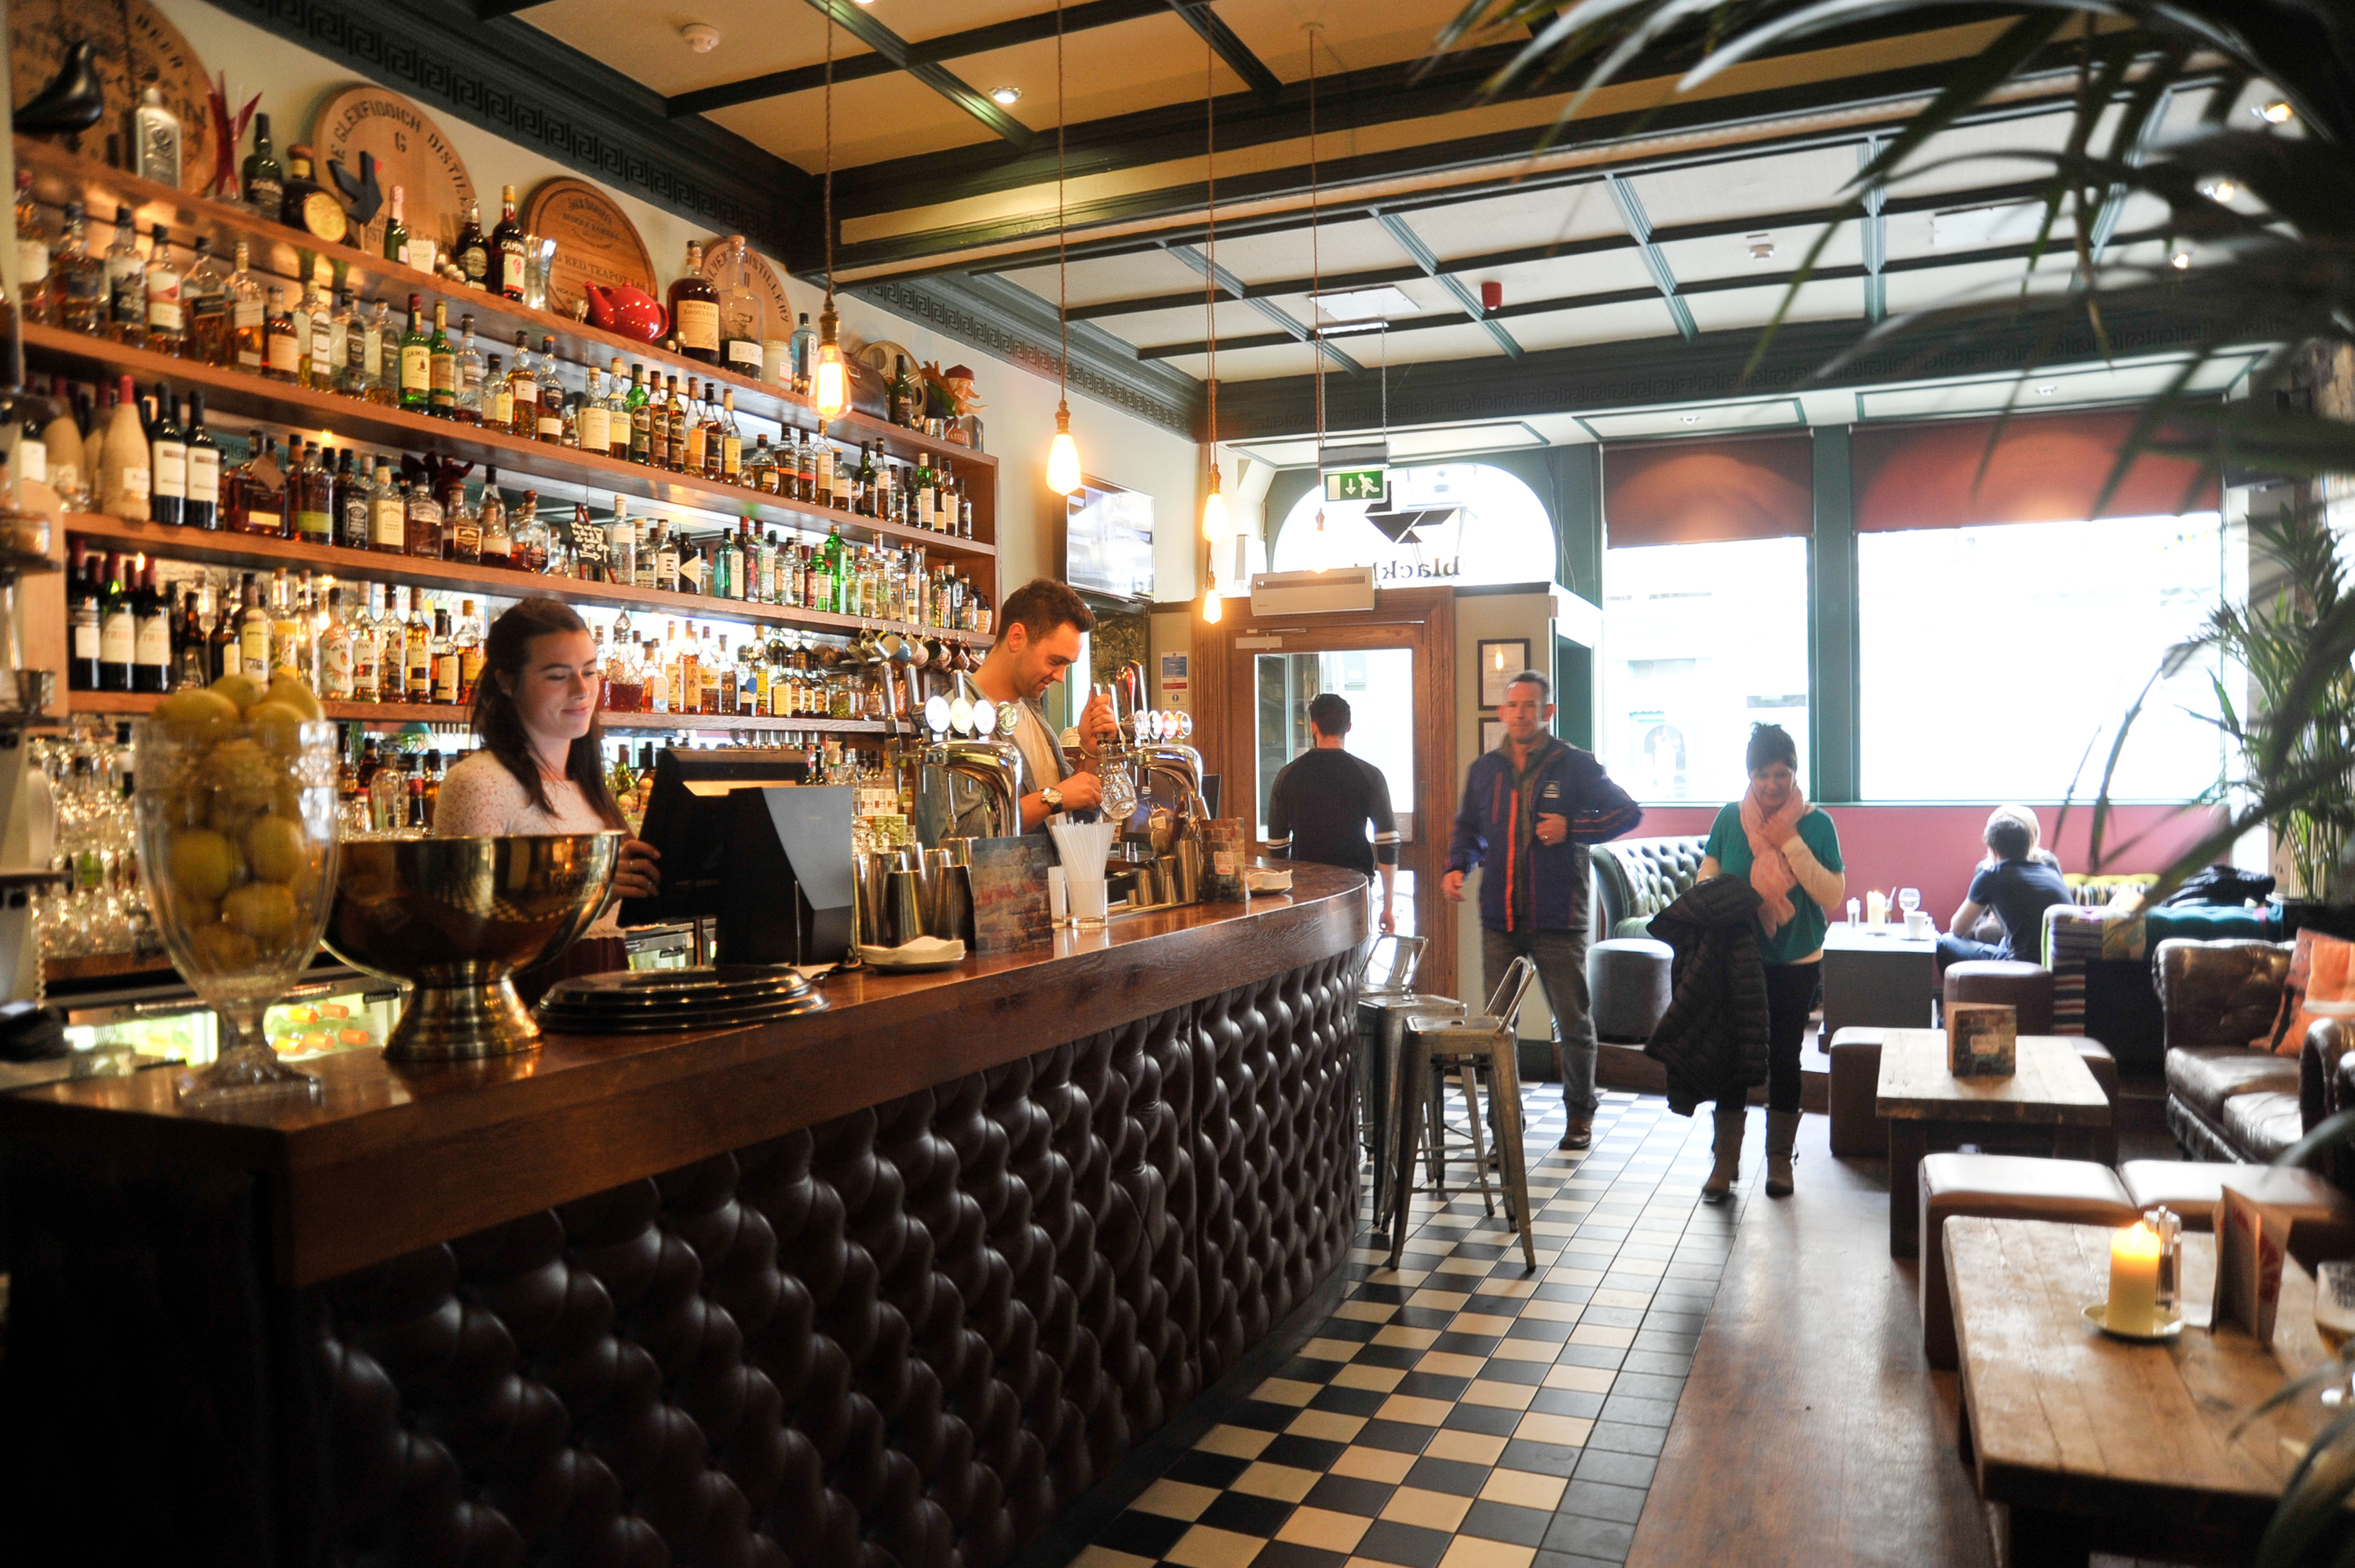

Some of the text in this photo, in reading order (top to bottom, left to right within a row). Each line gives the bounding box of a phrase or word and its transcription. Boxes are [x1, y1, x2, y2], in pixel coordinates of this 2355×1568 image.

[395, 132, 407, 152] G
[565, 255, 586, 270] RED
[589, 264, 629, 284] TEAPOT
[683, 308, 716, 319] SHOULDER
[686, 302, 714, 312] MONKEY
[556, 884, 604, 897] RESER
